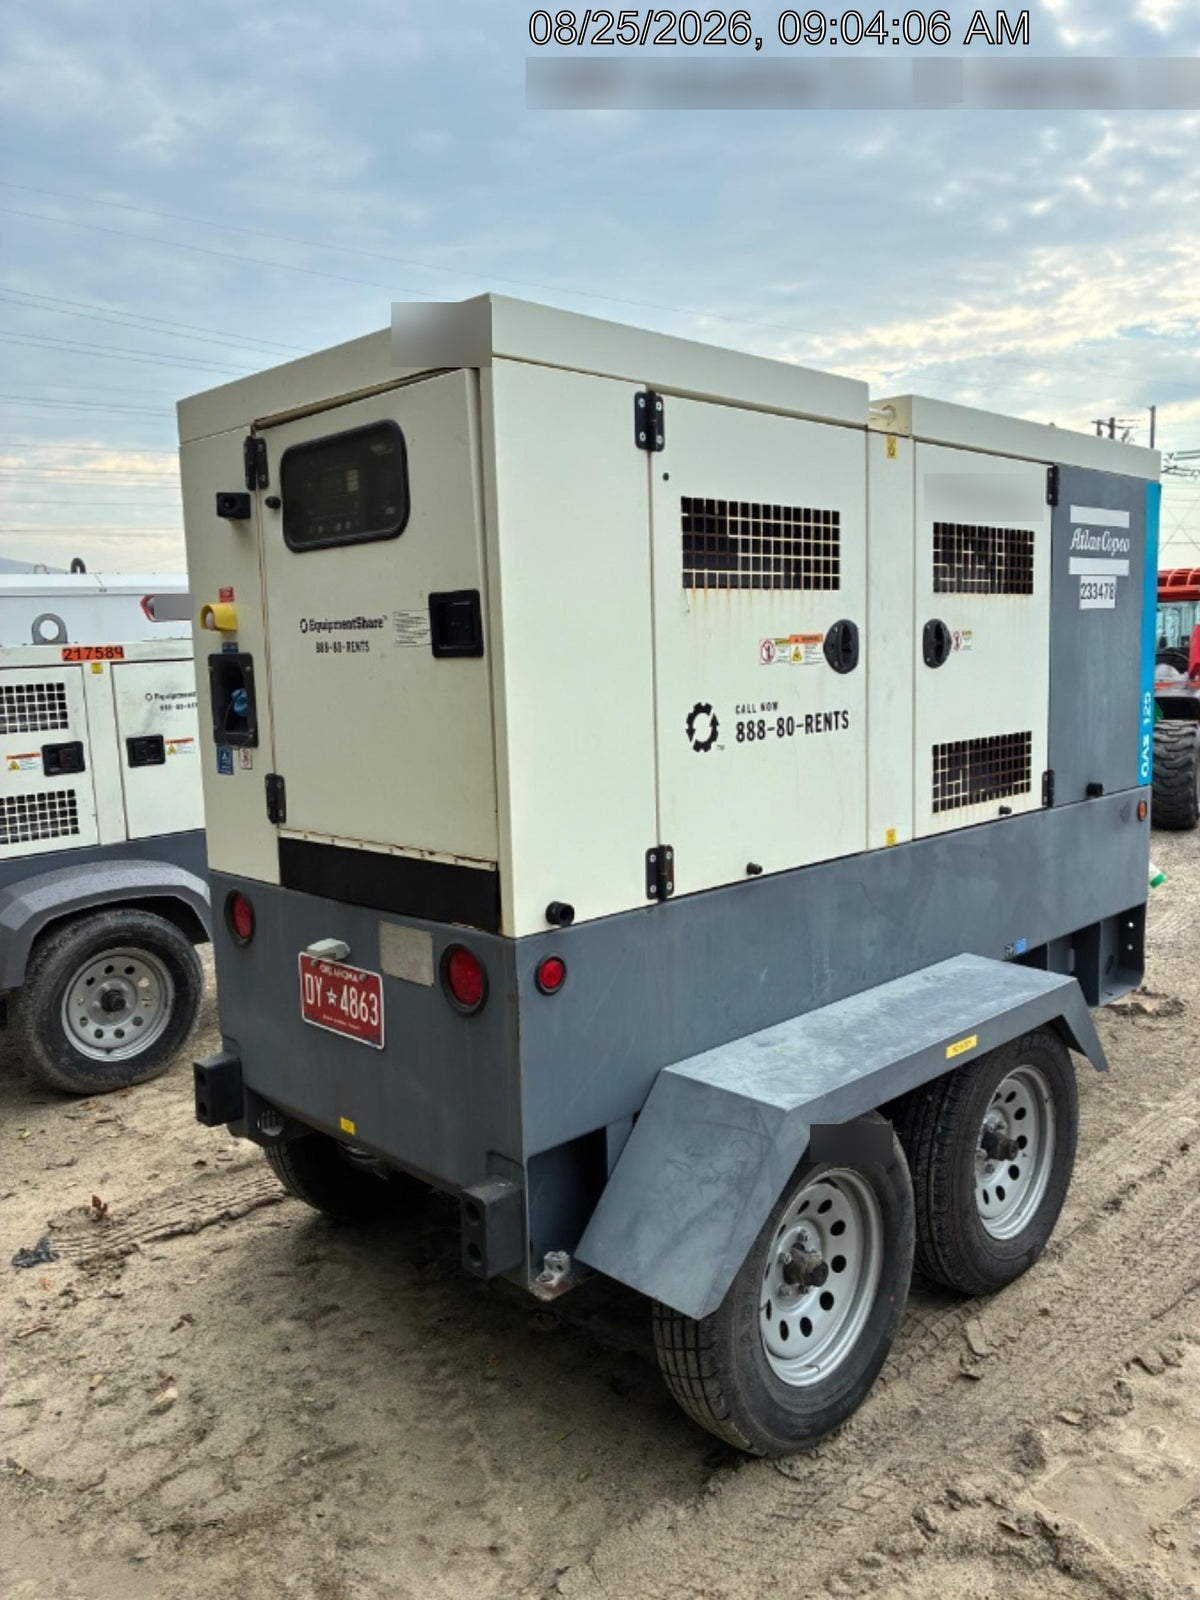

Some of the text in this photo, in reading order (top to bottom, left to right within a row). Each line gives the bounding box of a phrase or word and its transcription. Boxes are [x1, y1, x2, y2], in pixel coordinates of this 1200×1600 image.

[1080, 582, 1115, 600] 233478
[308, 616, 384, 633] EquipmentShare
[62, 646, 124, 660] 217589
[735, 701, 778, 715] CALL NOW
[735, 710, 849, 743] 888-80-RENTS
[304, 972, 323, 1007] DY
[340, 984, 379, 1026] 4863
